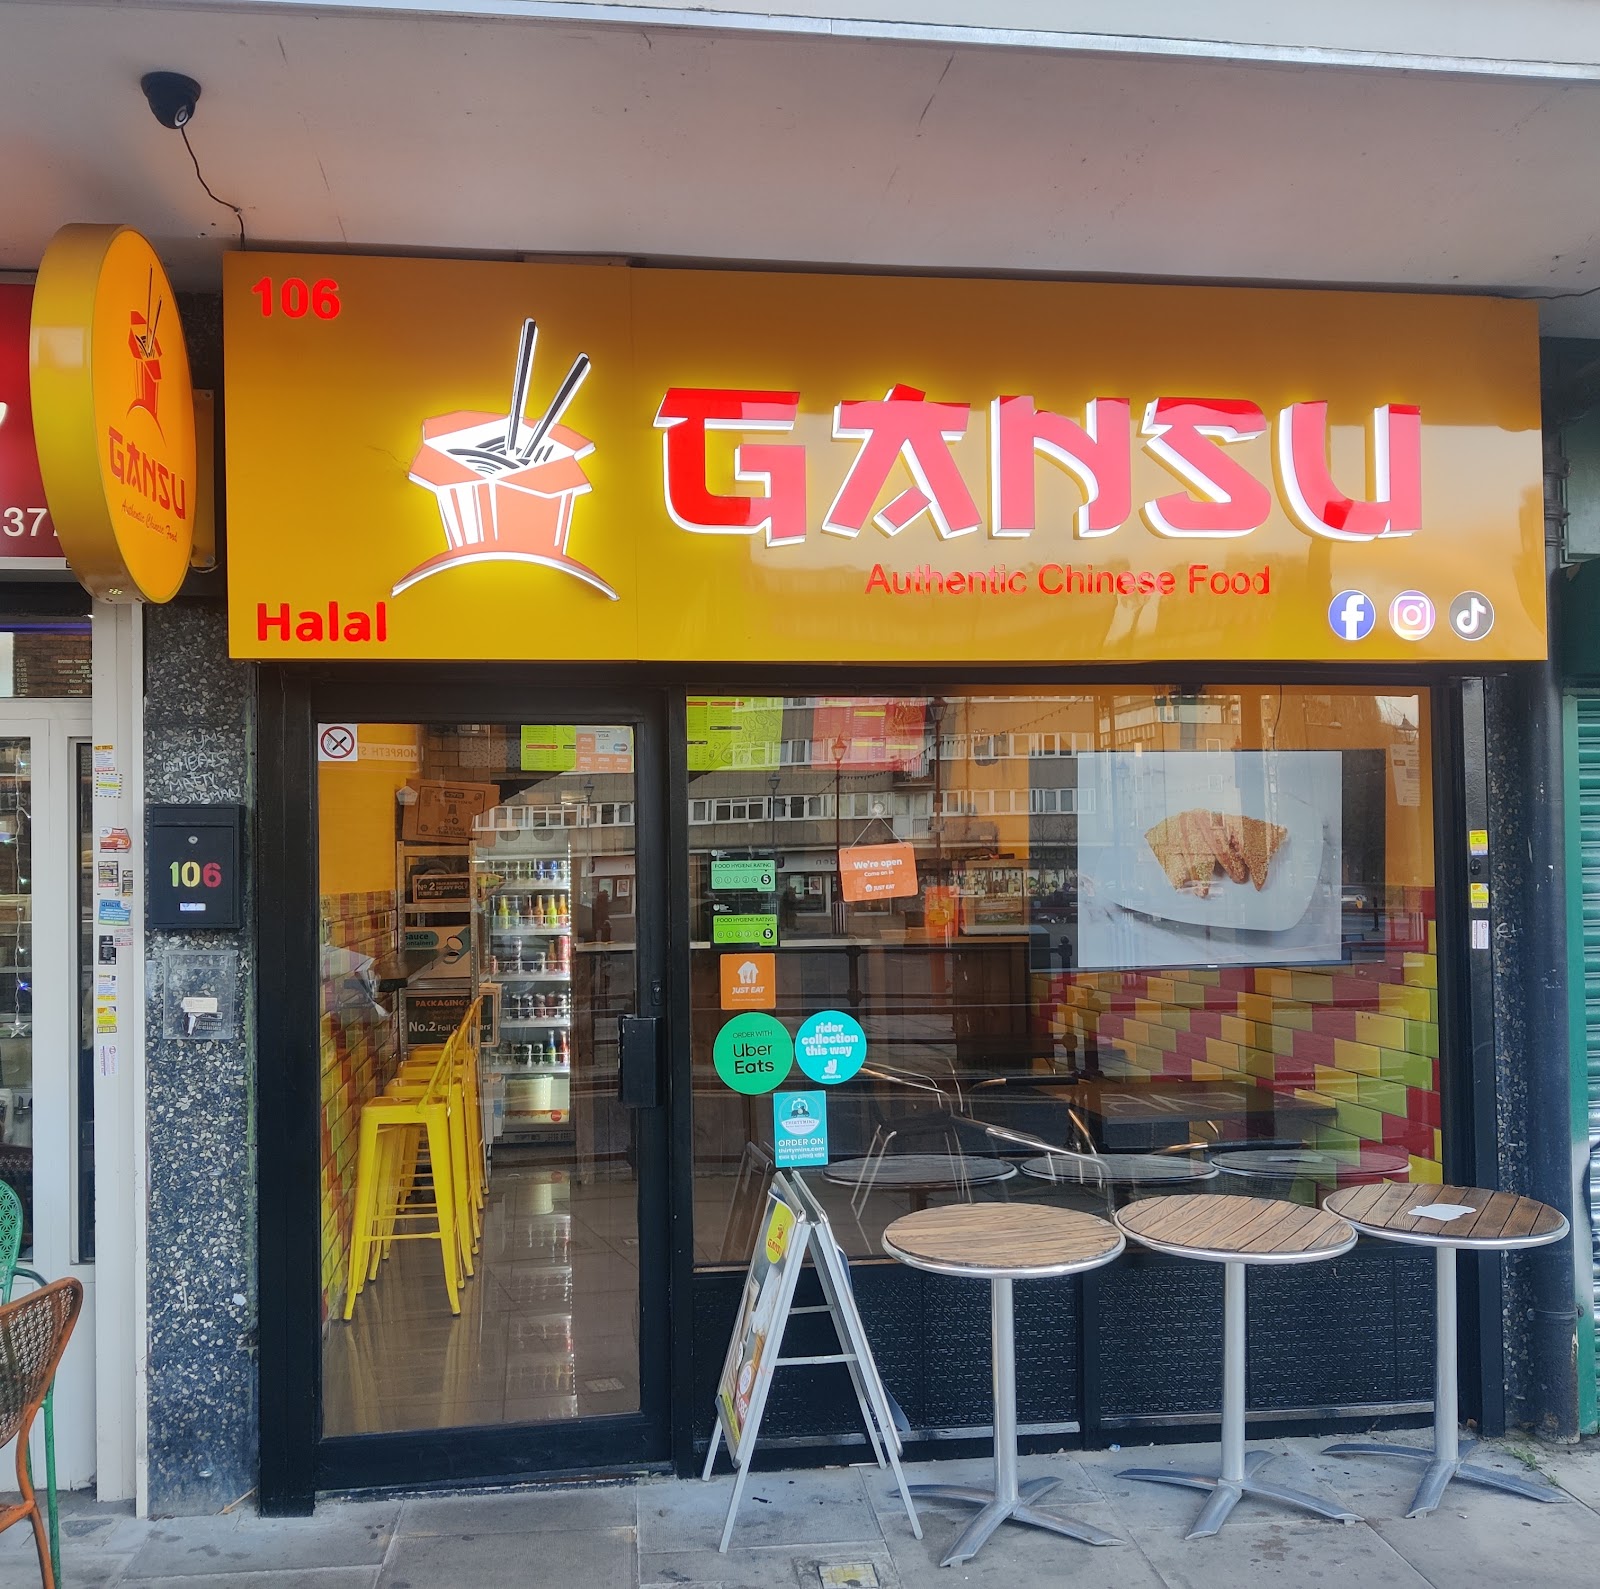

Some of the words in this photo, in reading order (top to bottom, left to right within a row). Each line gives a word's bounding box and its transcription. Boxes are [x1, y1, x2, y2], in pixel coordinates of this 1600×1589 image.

[252, 277, 341, 321] 106
[653, 383, 1422, 547] GANSU
[108, 425, 186, 520] GANSU
[3, 506, 58, 537] 37
[865, 563, 1027, 595] Authentic
[1038, 564, 1176, 595] Chinese
[1189, 565, 1270, 595] Food
[257, 601, 387, 643] Halal
[853, 860, 879, 869] We're
[880, 858, 903, 869] open
[169, 861, 222, 888] 106
[763, 875, 770, 885] 5
[429, 881, 436, 890] 2
[765, 929, 772, 939] 5
[732, 986, 750, 995] JUST
[750, 986, 765, 994] EAT
[408, 1021, 436, 1032] No.2
[815, 1021, 844, 1034] rider
[732, 1031, 755, 1039] ORDER
[801, 1033, 859, 1045] collection
[733, 1043, 773, 1058] Uber
[805, 1045, 828, 1056] this
[829, 1045, 853, 1057] way
[734, 1059, 775, 1075] Eats
[778, 1138, 808, 1147] ORDER
[810, 1137, 824, 1145] ON
[778, 1146, 825, 1154] thirtymins.com
